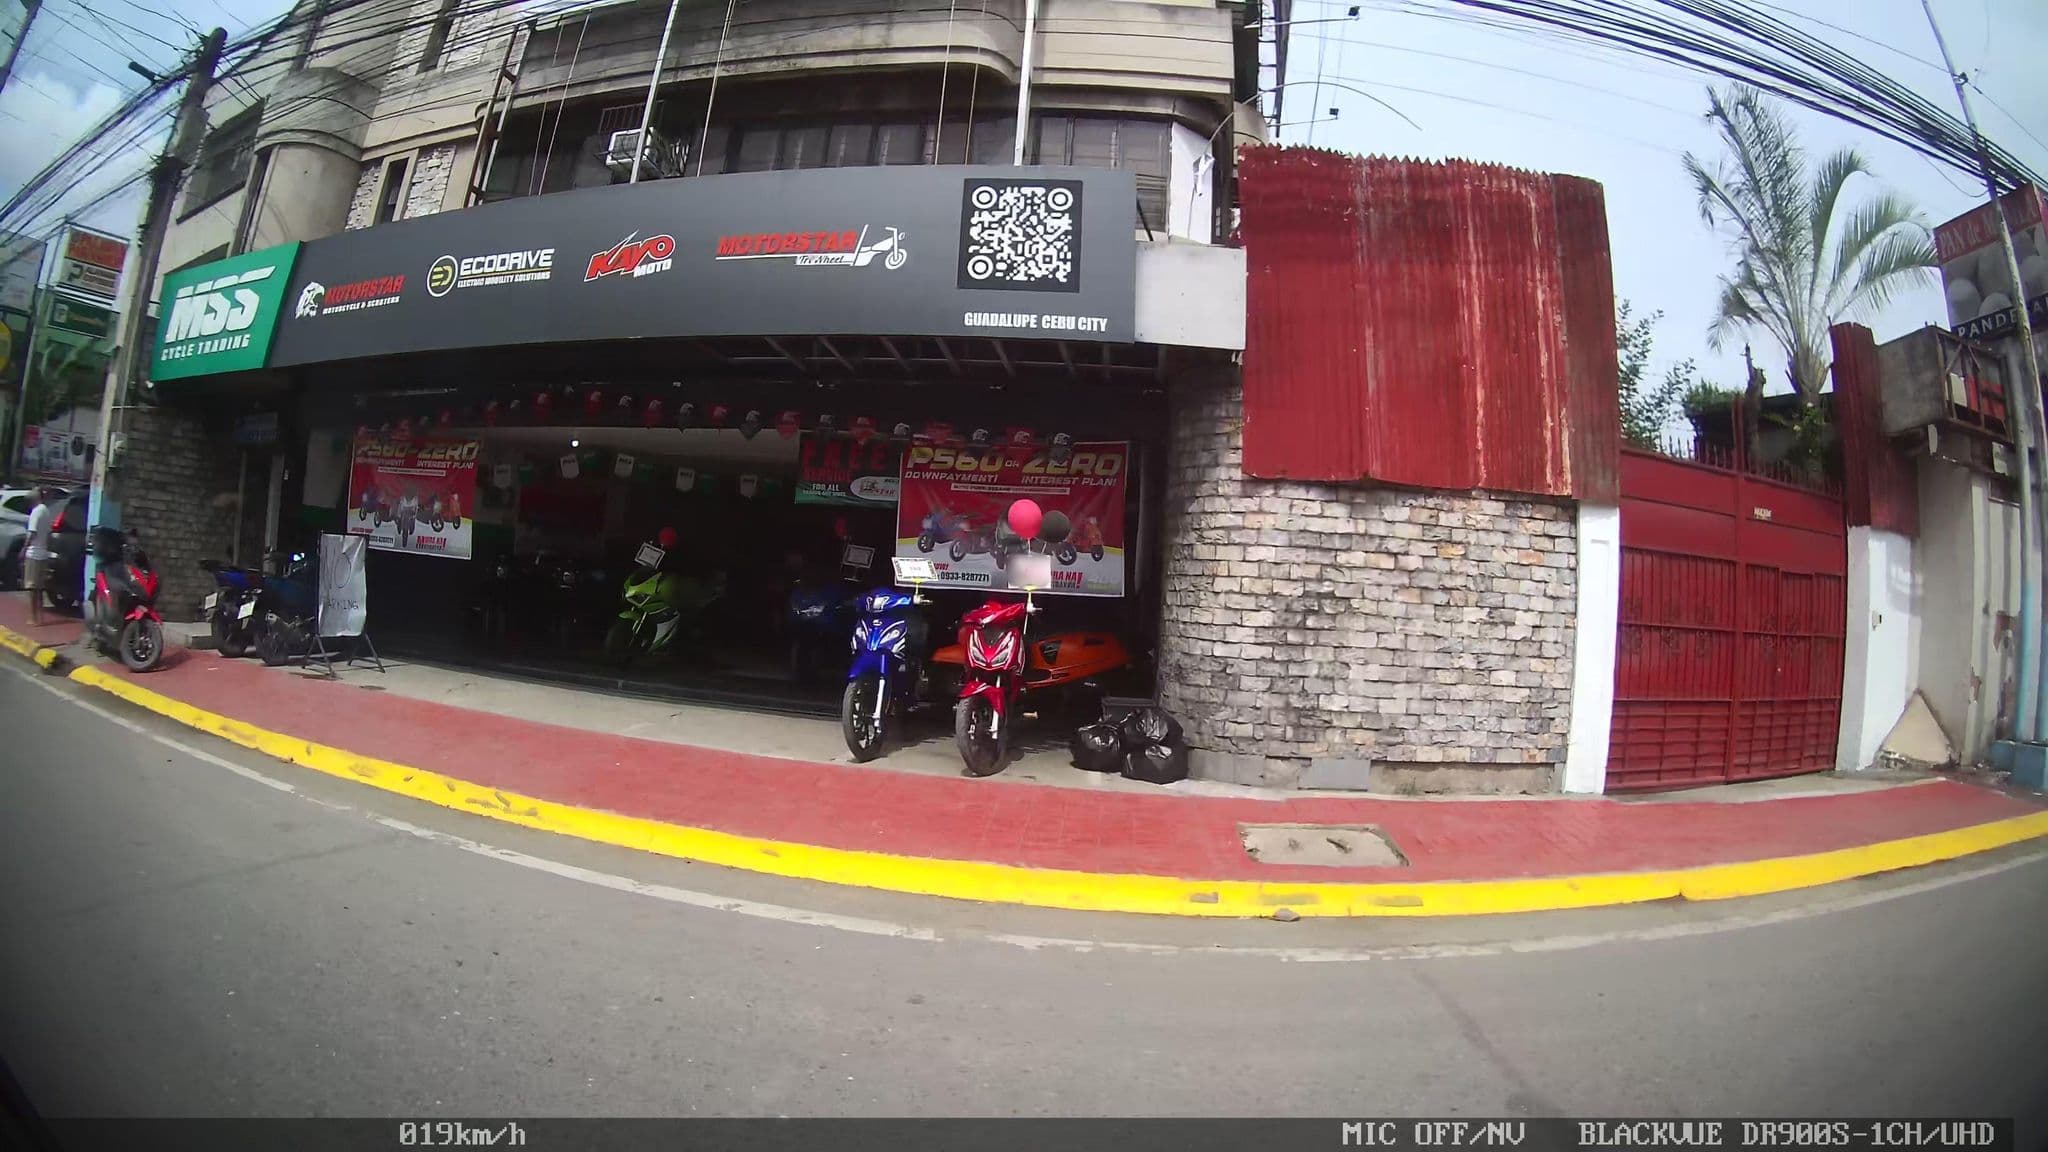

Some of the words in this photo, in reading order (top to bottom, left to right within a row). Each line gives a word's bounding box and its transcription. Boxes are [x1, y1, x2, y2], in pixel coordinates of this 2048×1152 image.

[717, 230, 858, 256] MOTORSTAR
[460, 248, 555, 276] ECODRIVE
[634, 258, 672, 278] MOTO
[324, 274, 407, 304] MOTORSTAR
[457, 278, 484, 288] ELECTRIC
[485, 275, 513, 286] MOBILITY
[514, 271, 551, 282] SOLUTIONS
[165, 265, 276, 344] MSS
[964, 312, 1038, 329] GUADALUPE
[1041, 314, 1076, 330] CEBU
[1078, 316, 1108, 332] CITY
[161, 343, 194, 361] CYCLE
[197, 333, 251, 354] TRADING
[417, 441, 480, 461] ZERO
[1022, 451, 1124, 477] ZERO
[905, 471, 999, 484] DOWNPAYMENT!
[1021, 474, 1079, 486] INTEREST
